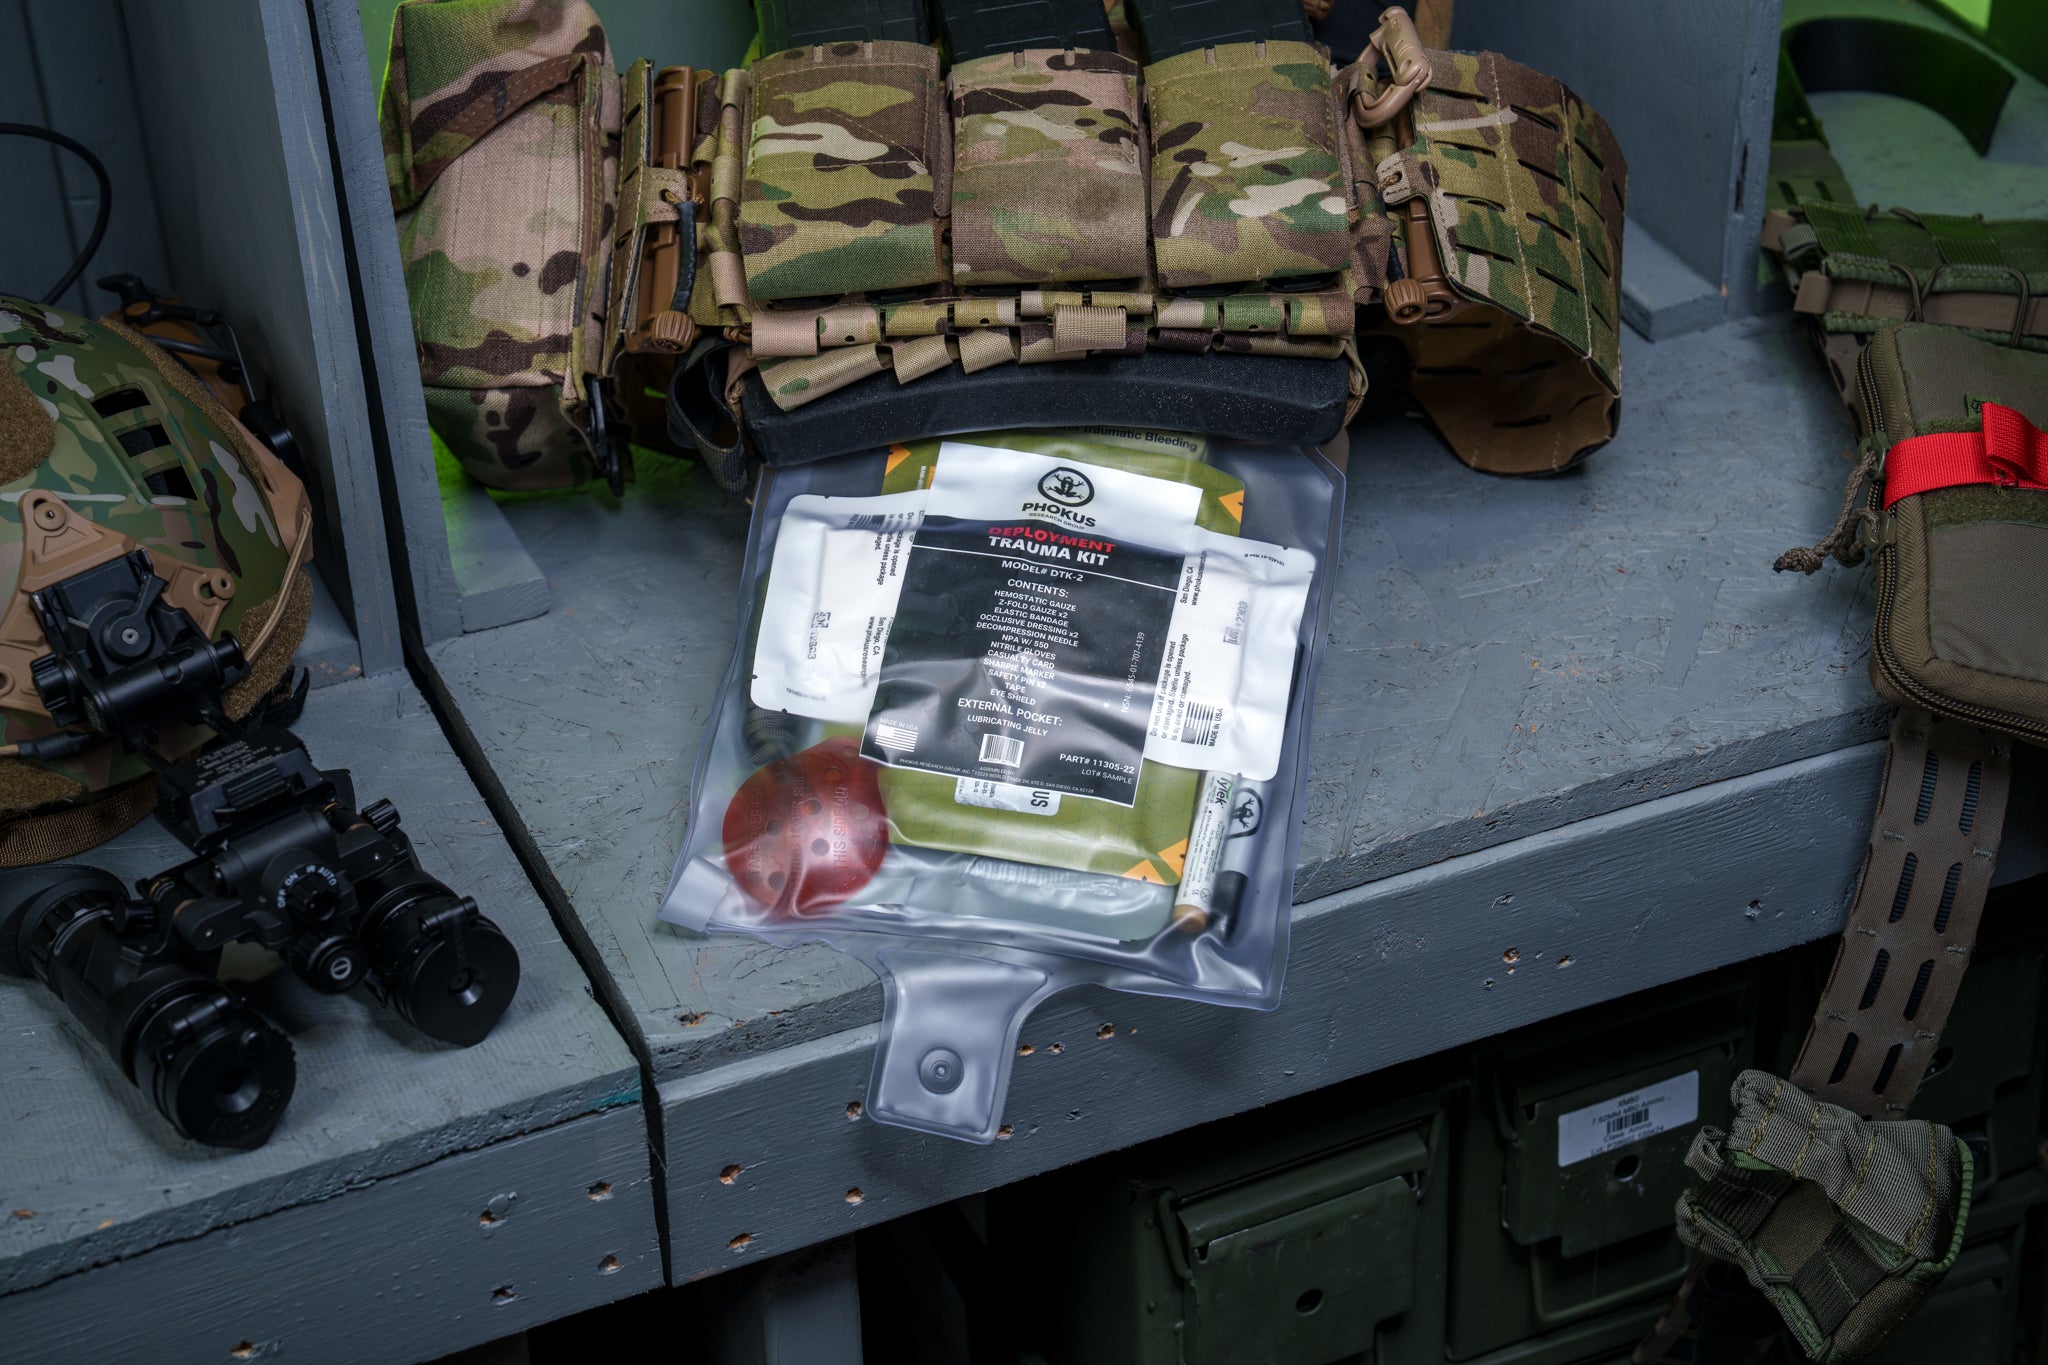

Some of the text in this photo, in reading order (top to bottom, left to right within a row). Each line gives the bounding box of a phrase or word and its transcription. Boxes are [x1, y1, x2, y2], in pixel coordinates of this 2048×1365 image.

[1145, 432, 1197, 452] Bleeding
[1021, 502, 1096, 528] PHOKUS
[1028, 512, 1085, 530] RESEARCH GROUP
[988, 526, 1116, 553] DEPLOYMENT
[882, 544, 890, 560] unless
[988, 536, 1109, 566] TRAUMA KIT
[877, 562, 887, 585] package
[890, 556, 898, 576] opened
[1002, 560, 1084, 582] MODEL# DTK-2
[1008, 579, 1068, 598] CONTENTS:
[1180, 566, 1194, 604] San Diego, CA
[994, 590, 1077, 612] HEMOSTATIC GAUZE
[998, 599, 1028, 609] Z-FOLD
[1030, 605, 1056, 616] GAUZE
[980, 614, 1025, 627] OCCLUSIVE
[1027, 622, 1067, 636] DRESSING
[994, 607, 1068, 627] ELASTIC BANDAGE
[873, 616, 886, 655] San Diego, CA
[976, 622, 1078, 647] DECOMPRESSION NEEDLE
[1002, 634, 1049, 649] NPA W/ 550
[988, 650, 1054, 669] CASUALTY CARD
[991, 641, 1056, 660] NITRILE GLOVES
[984, 658, 1055, 679] SHARPIE MARKER
[988, 669, 1019, 681] SAFETY
[1021, 676, 1035, 685] PIN
[1005, 682, 1026, 693] TAPE
[1150, 727, 1157, 737] Do
[1161, 669, 1171, 694] package
[1167, 641, 1176, 662] opened
[1164, 699, 1174, 730] damaged.
[1169, 677, 1178, 698] Sterile
[1174, 658, 1183, 676] unless
[1179, 634, 1189, 658] package
[1181, 671, 1191, 699] damaged.
[990, 689, 1035, 706] EYE SHIELD
[1179, 700, 1184, 708] or
[958, 698, 1062, 726] EXTERNAL POCKET:
[880, 718, 898, 727] MADE
[906, 723, 919, 731] USA
[967, 714, 1048, 736] LUBRICATING JELLY
[1208, 730, 1218, 746] MADE
[1214, 708, 1224, 721] USA
[920, 760, 944, 770] RESEARCH
[990, 772, 1007, 781] WORLD
[1008, 776, 1021, 784] TRADE
[980, 766, 1006, 775] ASSEMBLED
[1060, 753, 1135, 774] PART# 11305-22
[1081, 768, 1133, 784] LOT# SAMPLE
[1030, 790, 1050, 808] US
[833, 786, 848, 871] THIS SIDE OUT
[748, 844, 760, 874] TAPE
[284, 872, 299, 886] ON
[317, 866, 337, 886] AUTO
[277, 888, 287, 909] OFF
